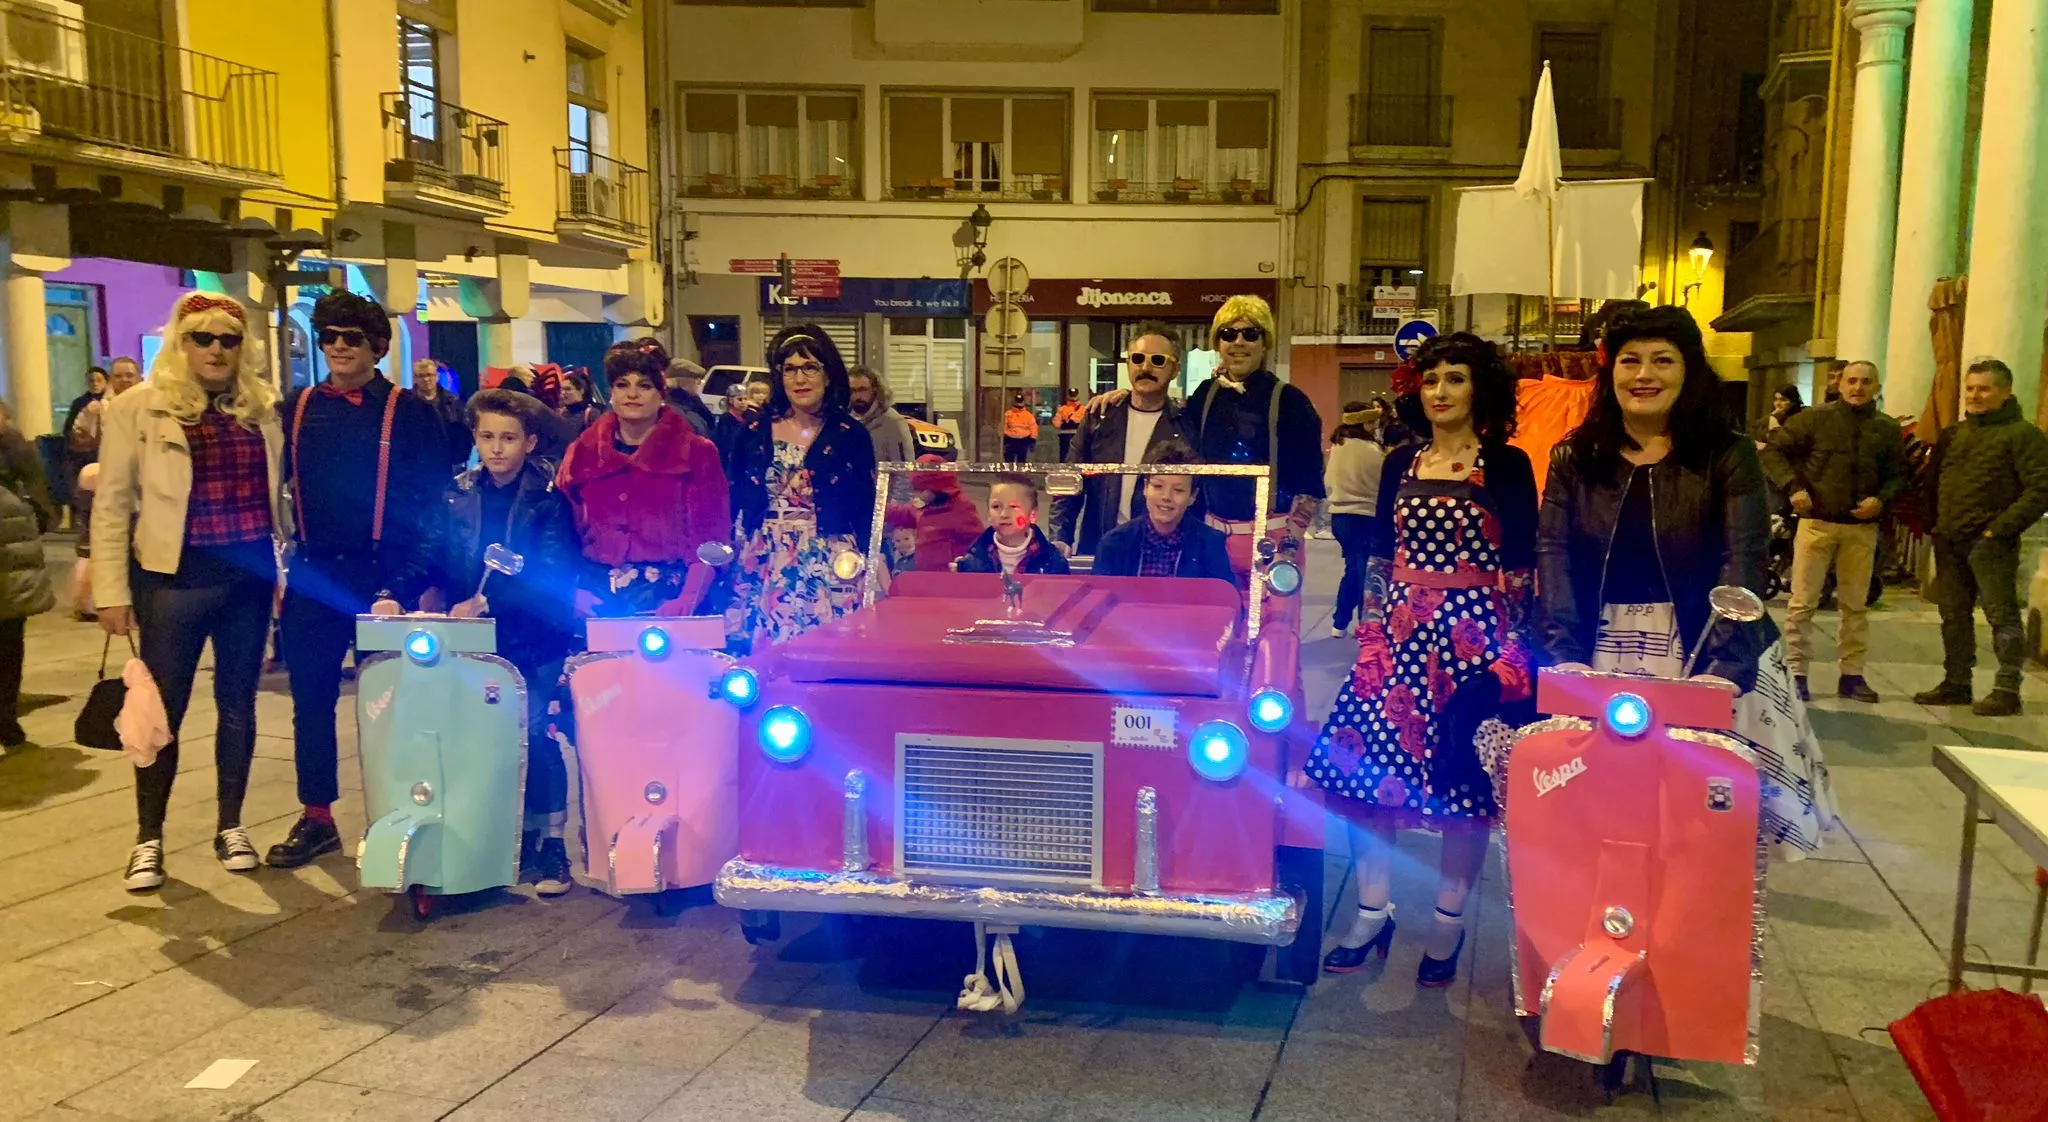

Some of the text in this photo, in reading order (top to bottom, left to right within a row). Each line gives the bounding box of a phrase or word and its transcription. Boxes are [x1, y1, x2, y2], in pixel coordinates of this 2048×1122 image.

[874, 299, 889, 307] You
[890, 299, 913, 307] break
[1076, 286, 1173, 308] Jijonenca
[1124, 714, 1151, 729] 001
[1532, 756, 1588, 797] Vespa
